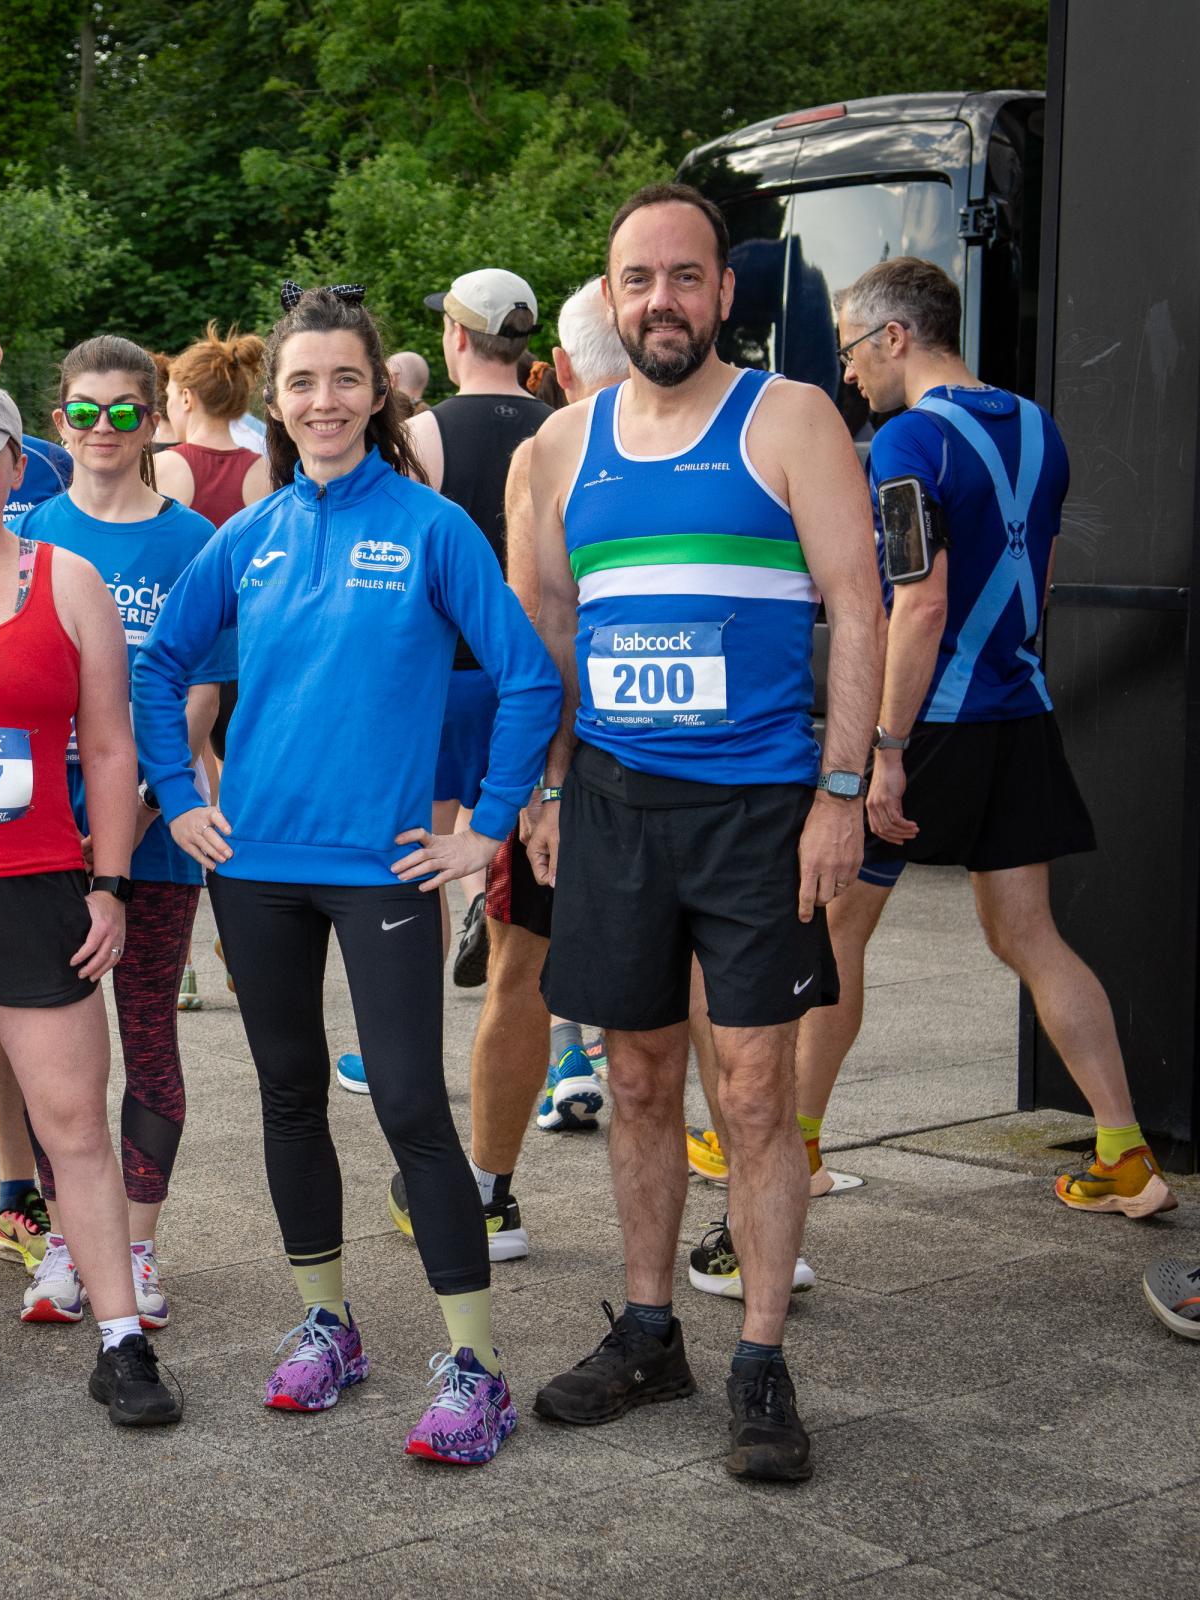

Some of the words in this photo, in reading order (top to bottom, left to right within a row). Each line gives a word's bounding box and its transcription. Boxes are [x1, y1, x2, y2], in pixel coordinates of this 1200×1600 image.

[674, 463, 710, 472] ACHILLES
[712, 462, 731, 471] HEEL
[354, 552, 404, 563] GLASGOW
[346, 578, 384, 589] ACHILLES
[386, 581, 406, 592] HEEL
[106, 583, 169, 610] ock
[613, 632, 692, 651] babcock
[613, 663, 694, 704] 200
[606, 715, 654, 724] HELENSBURGH
[673, 714, 701, 723] START
